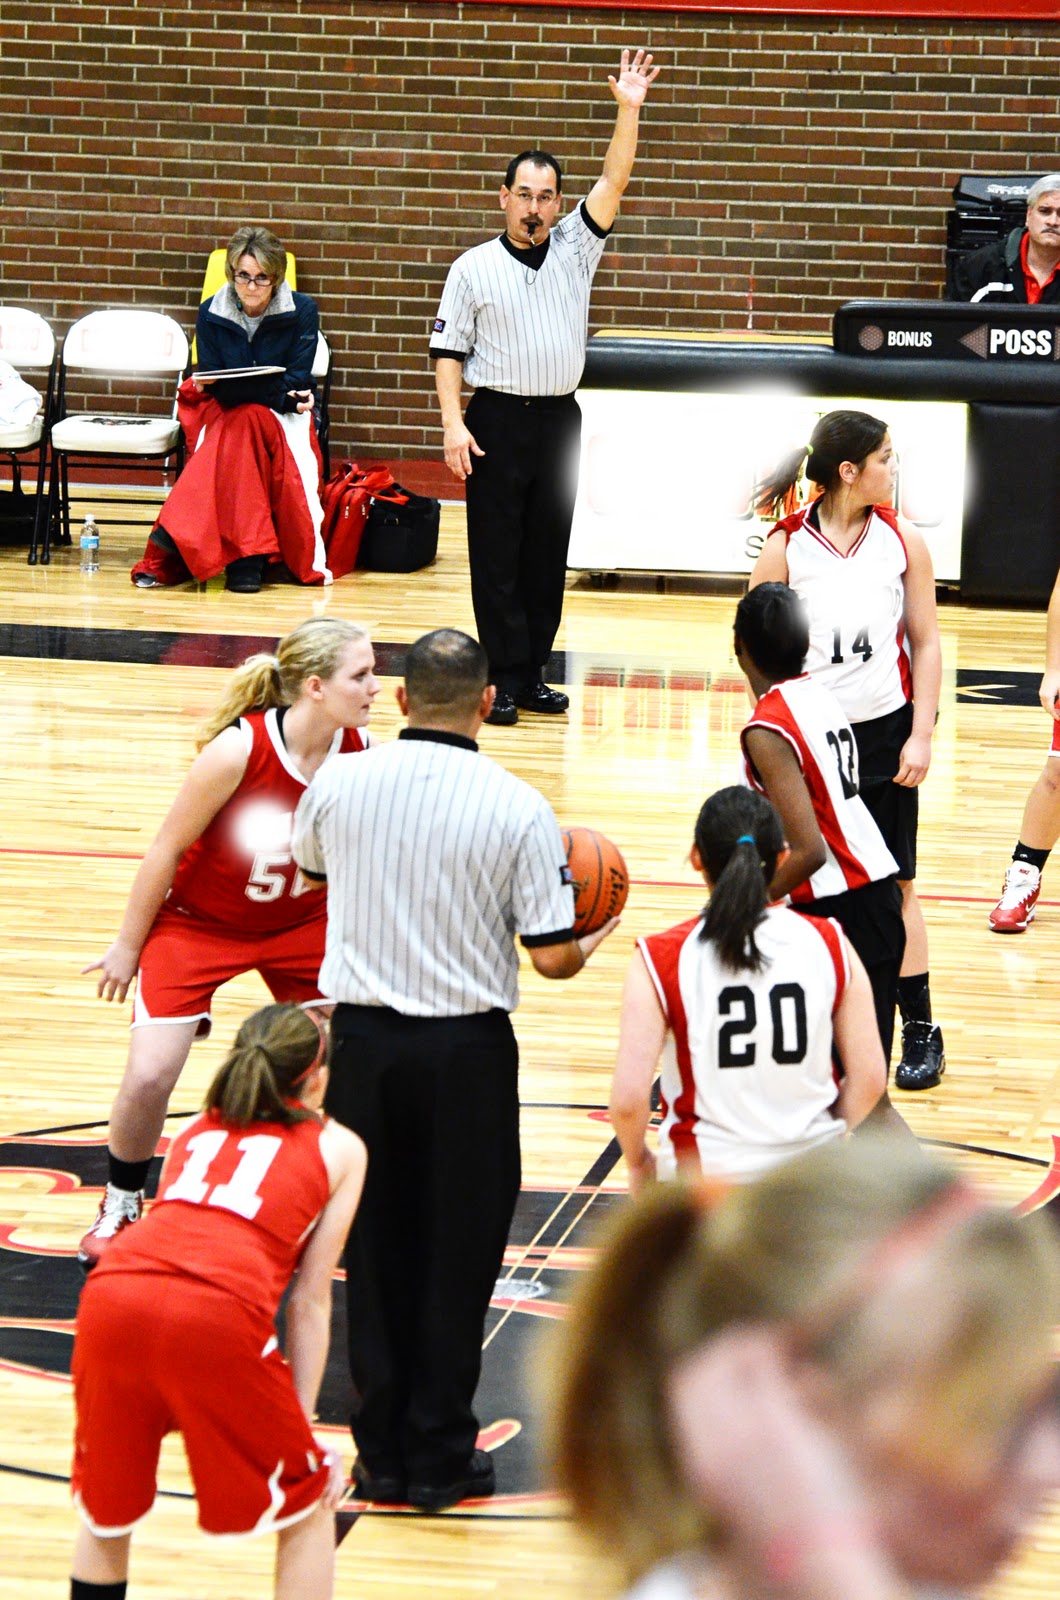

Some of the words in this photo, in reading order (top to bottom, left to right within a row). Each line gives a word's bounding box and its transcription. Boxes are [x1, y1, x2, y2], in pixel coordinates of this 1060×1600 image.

[887, 330, 933, 348] BONUS
[989, 328, 1053, 356] POSS
[830, 625, 873, 665] 14
[717, 982, 808, 1070] 20
[163, 1129, 283, 1221] 11
